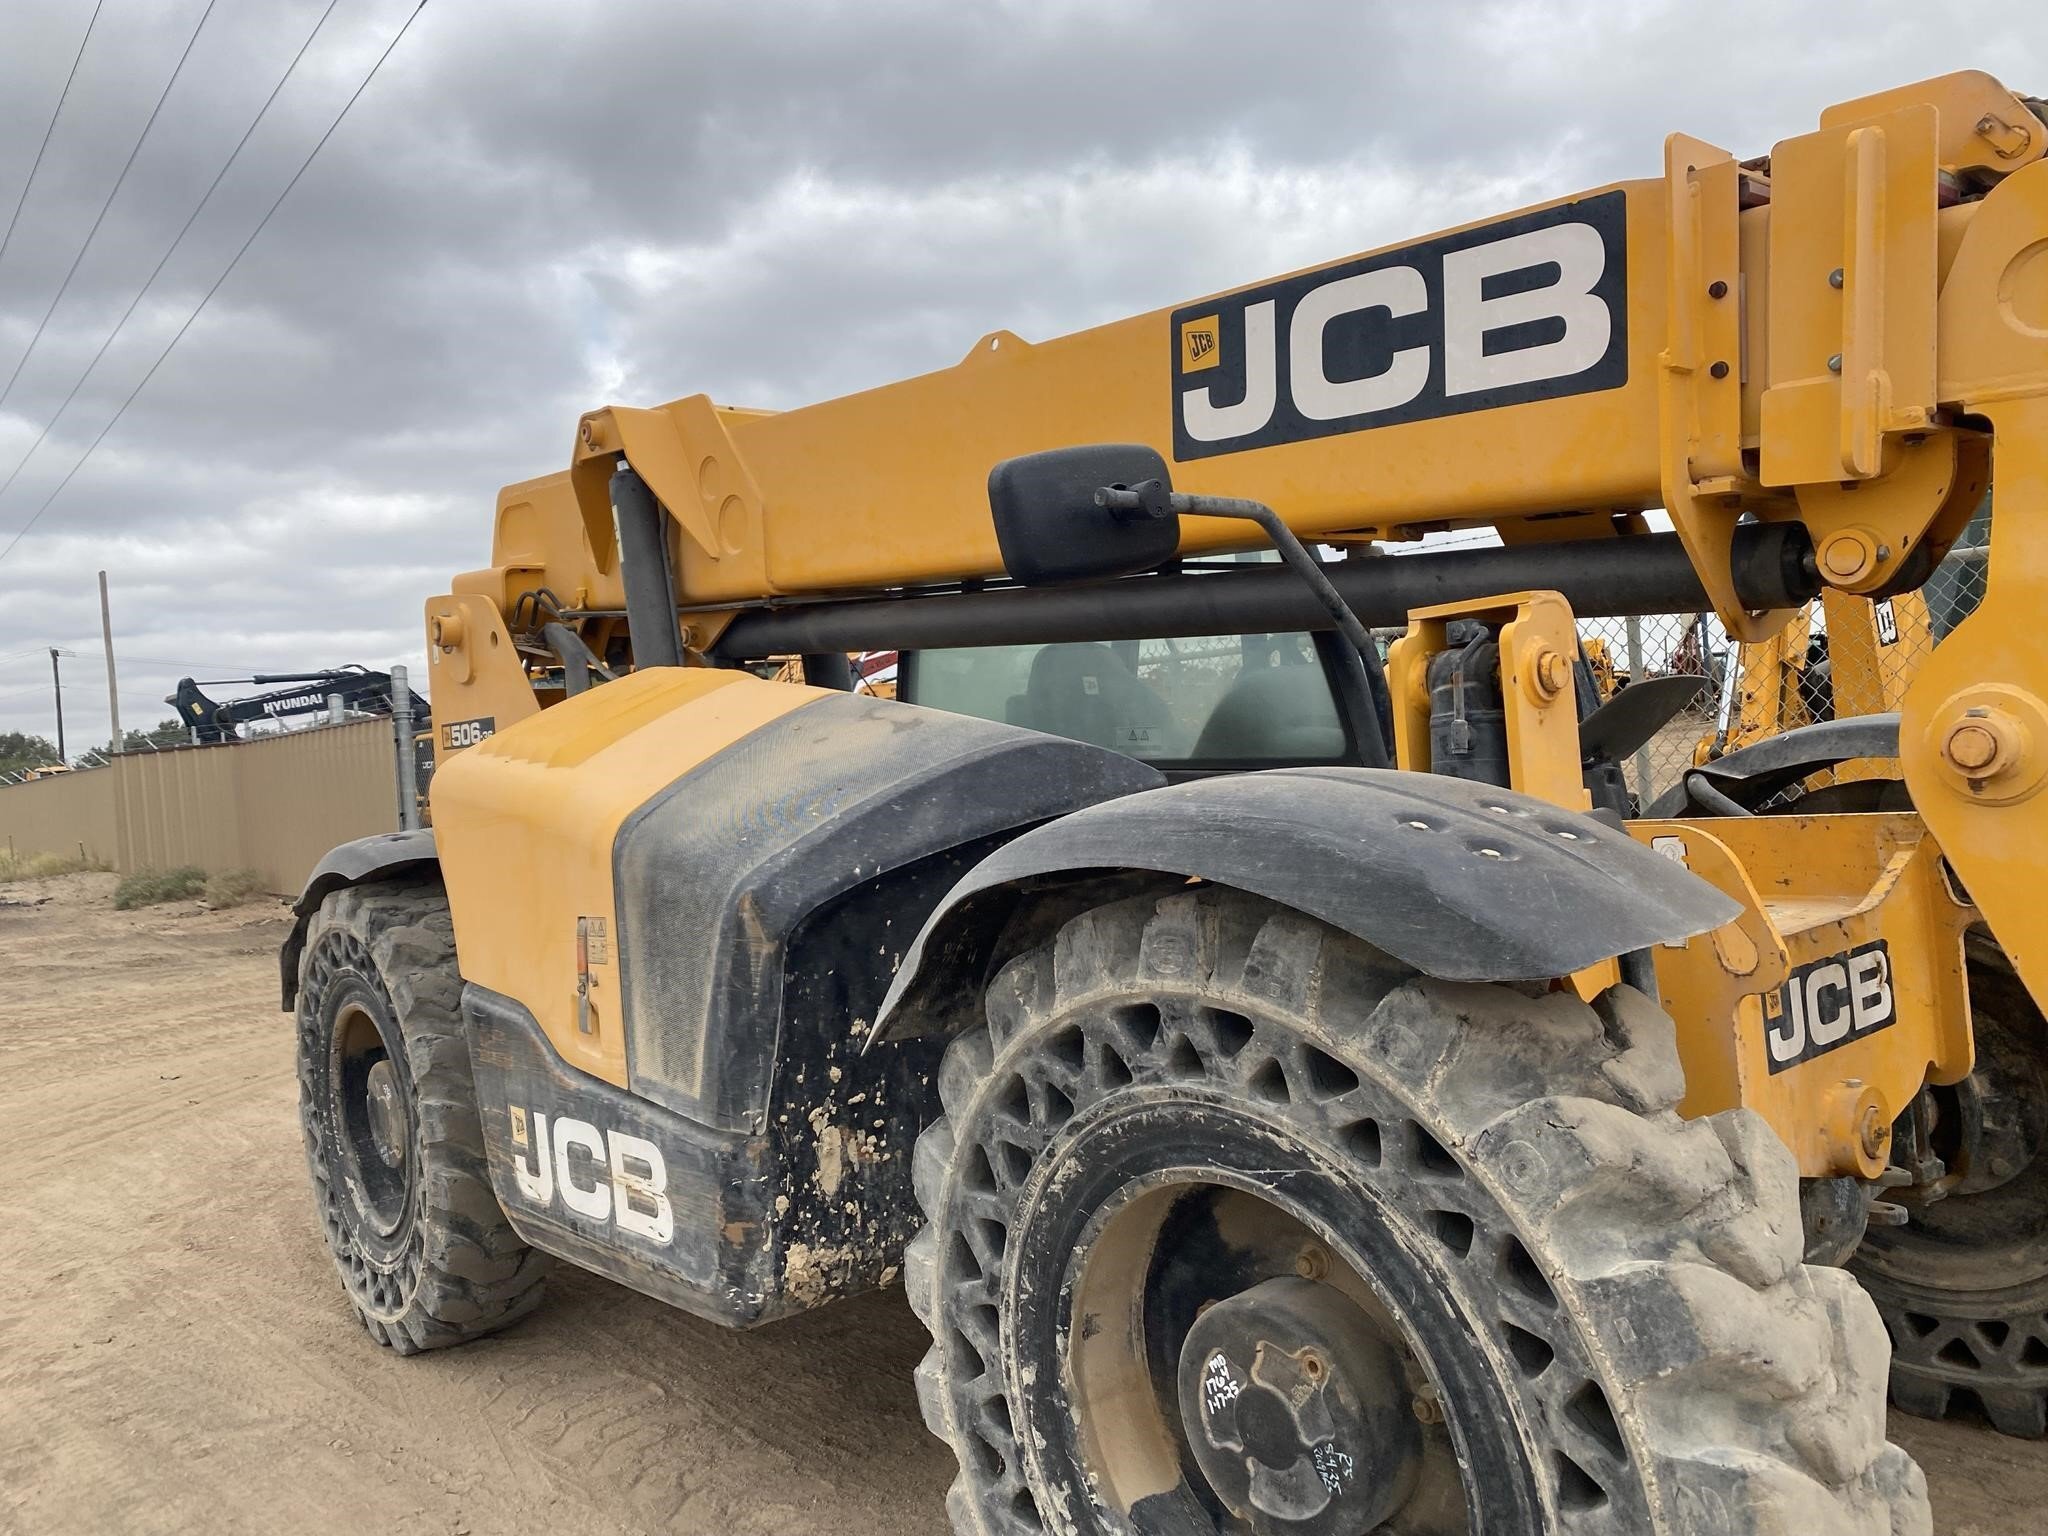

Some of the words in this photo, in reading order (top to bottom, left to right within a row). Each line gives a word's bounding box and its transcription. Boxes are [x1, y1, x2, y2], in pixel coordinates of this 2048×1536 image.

[1183, 222, 1611, 441] JCB
[1191, 333, 1213, 358] JCB
[263, 693, 323, 713] HYUNDAI
[1769, 950, 1892, 1062] JCB
[514, 1112, 673, 1243] JCB
